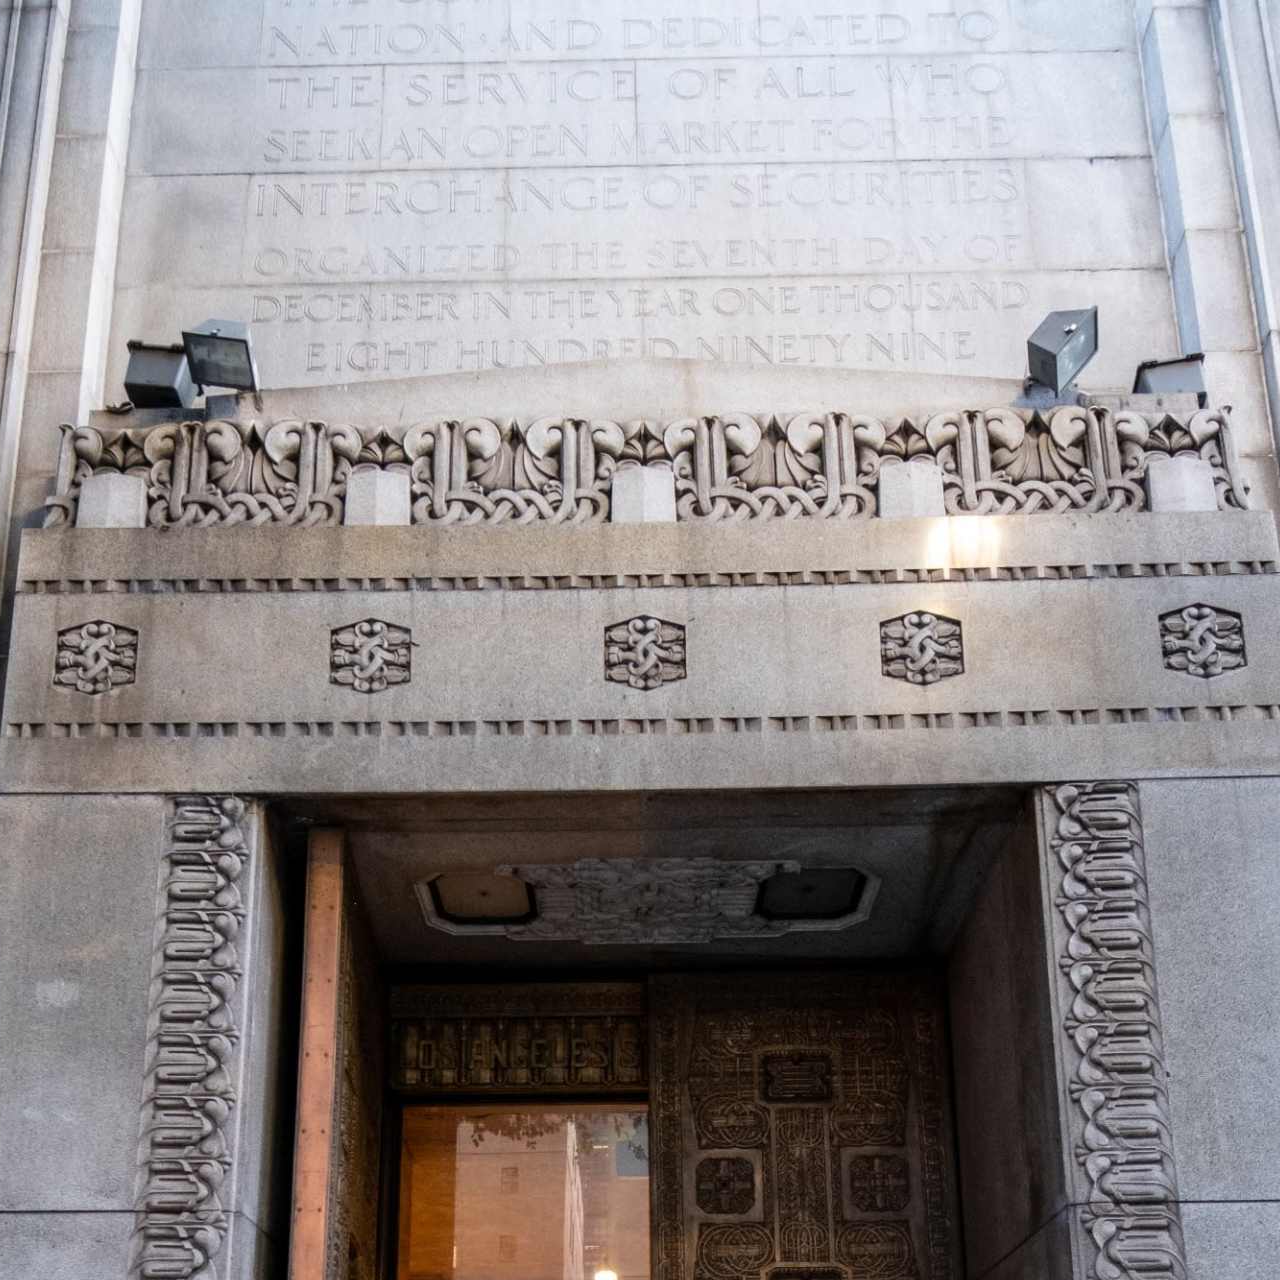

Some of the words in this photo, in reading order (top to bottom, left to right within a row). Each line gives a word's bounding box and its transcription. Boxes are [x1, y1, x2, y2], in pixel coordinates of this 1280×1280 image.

[490, 19, 602, 54] AND
[623, 14, 911, 50] DEDICATED
[927, 10, 999, 43] TO
[267, 75, 378, 110] THE
[405, 69, 638, 107] SERVICE
[668, 66, 737, 101] OF
[754, 65, 856, 99] ALL
[875, 62, 1008, 97] WHO
[263, 128, 379, 164] SEEK
[383, 125, 447, 162] AN
[462, 123, 588, 159] OPEN
[608, 119, 795, 157] MARKET
[809, 117, 902, 153] FOR
[919, 115, 1015, 150] THE
[256, 176, 628, 217] INTERCHANGE
[643, 174, 711, 210] OF
[730, 169, 1019, 208] SECURITIES
[253, 243, 522, 278] ORGANIZED
[542, 241, 627, 271] THE
[647, 237, 839, 269] SEVENTH
[863, 235, 950, 266] DAY
[964, 234, 1022, 264] OF
[251, 292, 460, 325] DECEMBER
[471, 290, 512, 321] IN
[523, 288, 600, 320] THE
[601, 287, 703, 319] YEAR
[710, 285, 802, 317] ONE
[809, 281, 1032, 314] THOUSAND
[306, 340, 439, 373] EIGHT
[455, 336, 680, 371] HUNDRED
[695, 332, 853, 365] NINETY
[864, 330, 976, 364] NINE
[469, 1038, 608, 1069] ANGELES
